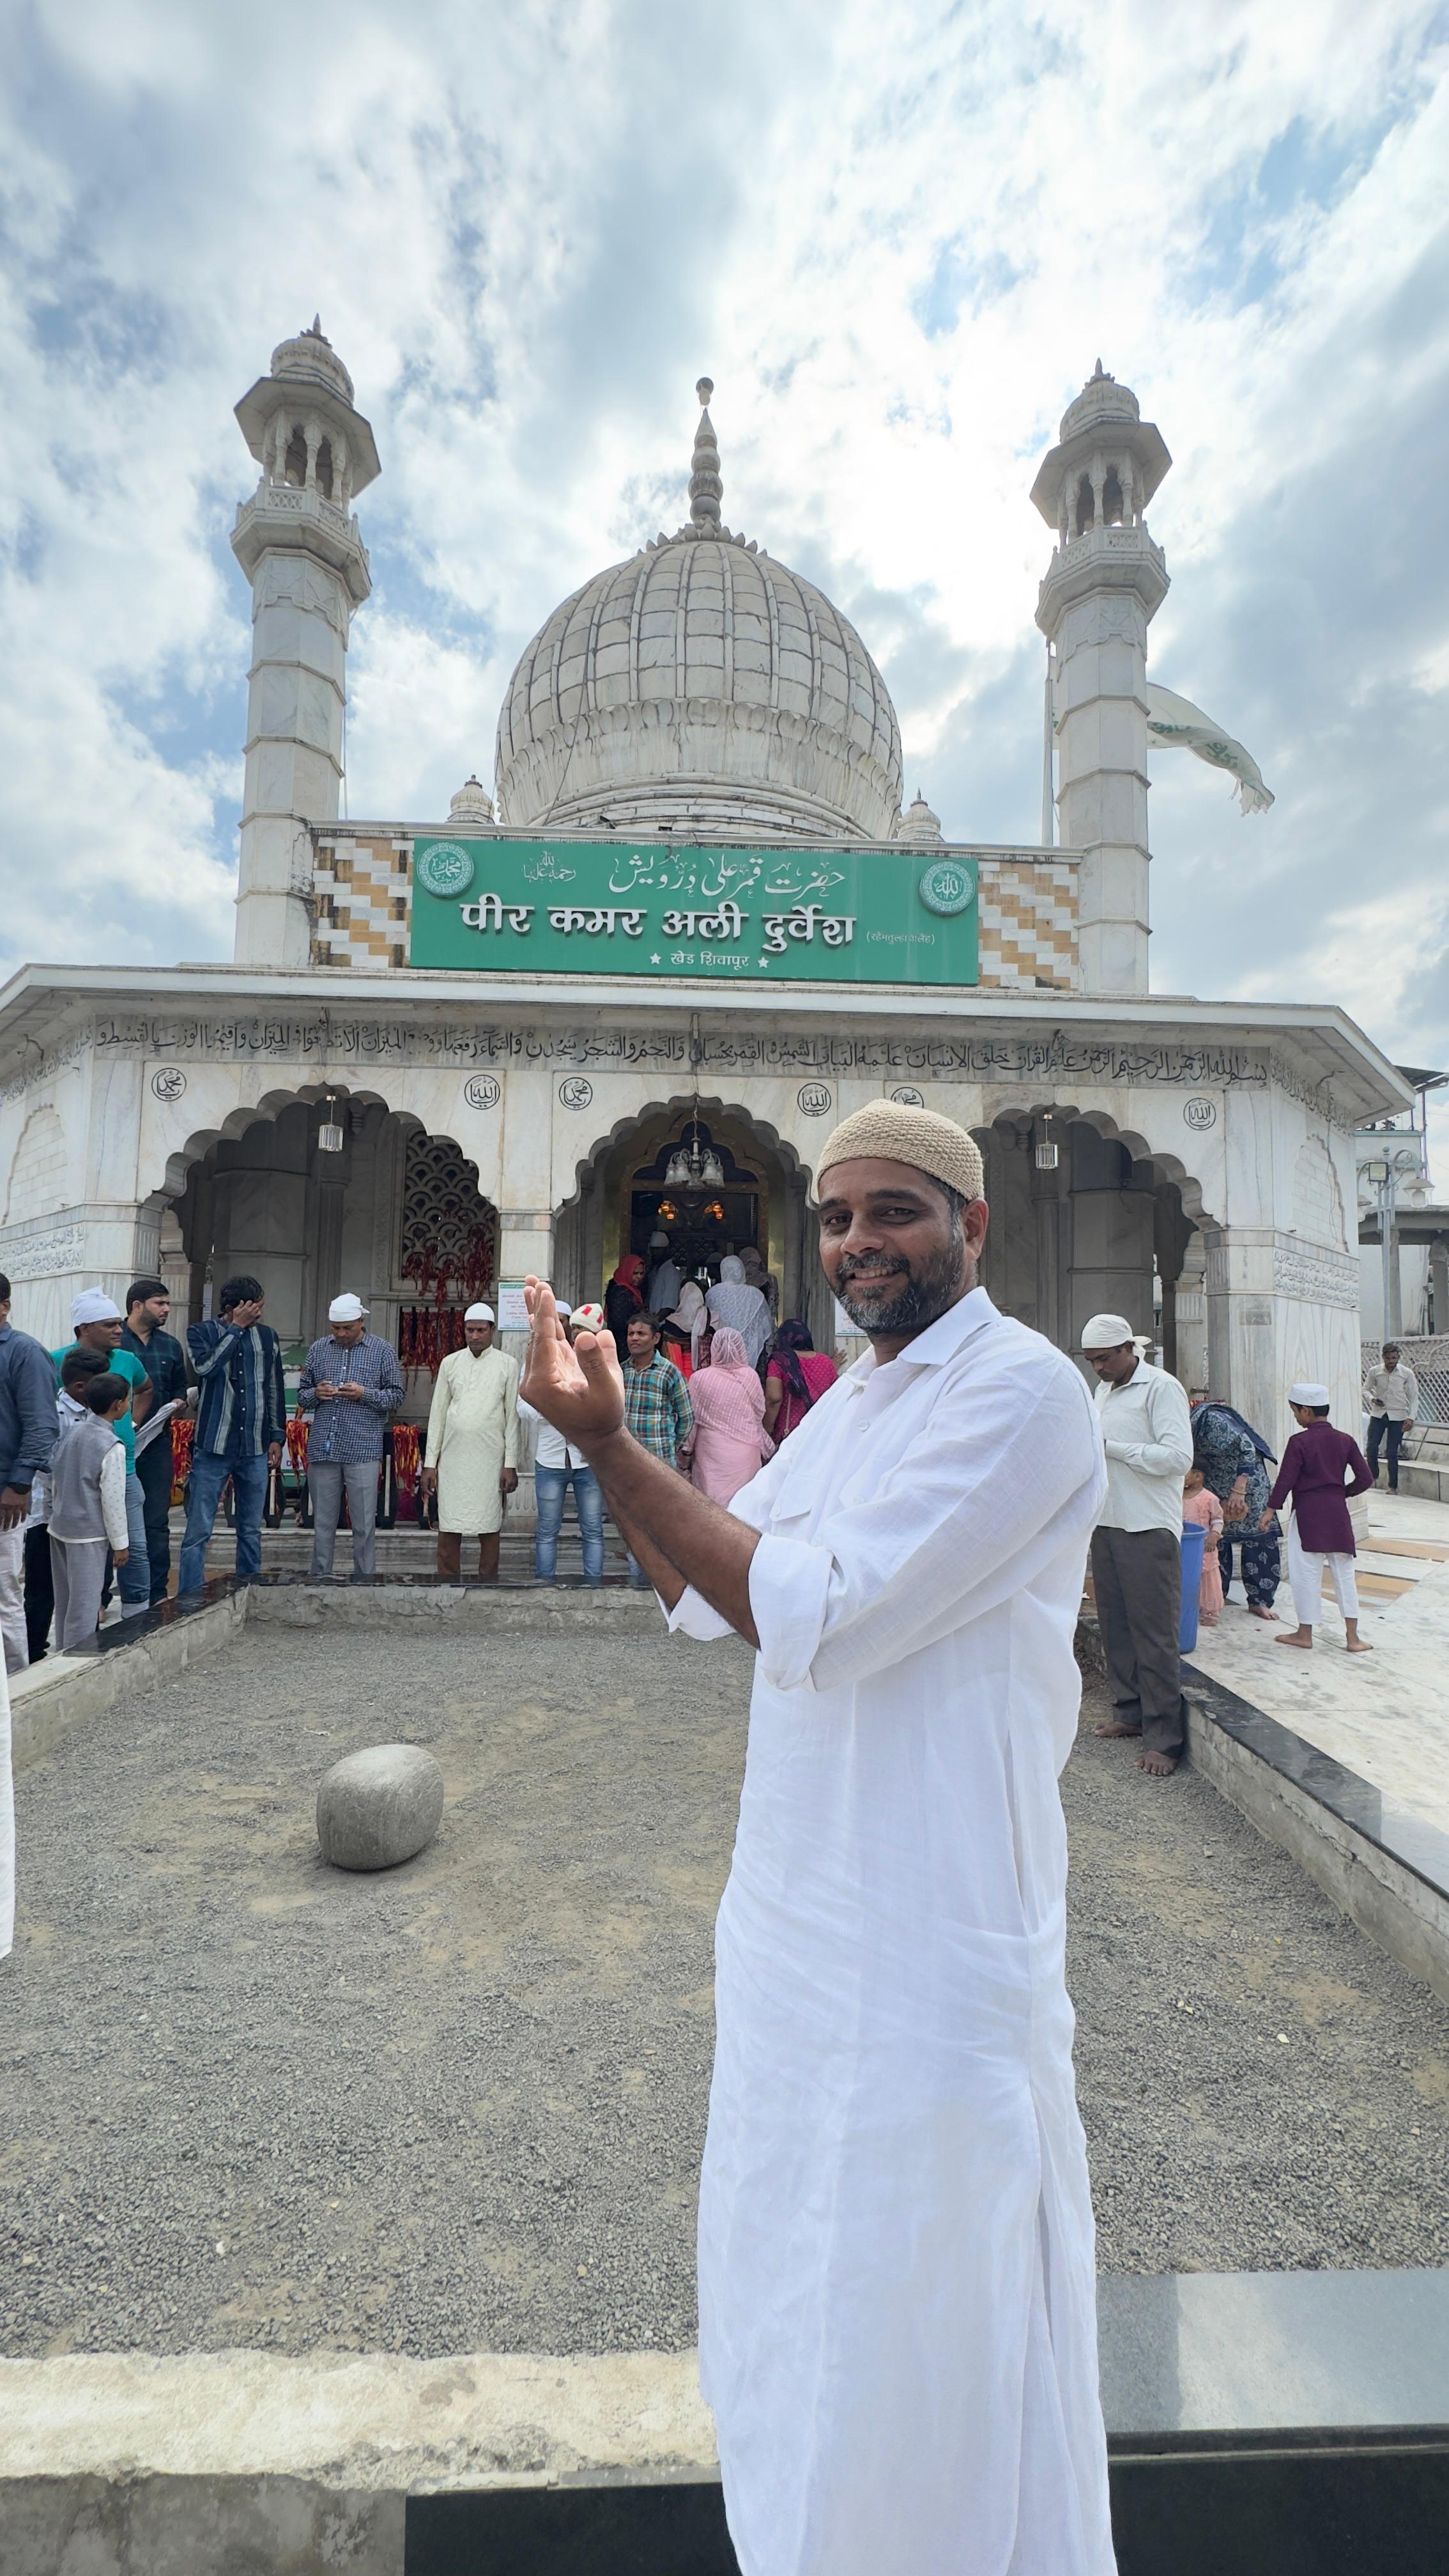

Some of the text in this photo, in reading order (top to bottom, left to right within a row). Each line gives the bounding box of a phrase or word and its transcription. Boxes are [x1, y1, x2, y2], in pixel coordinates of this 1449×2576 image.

[725, 855, 763, 900] قمر
[765, 865, 845, 901] حضرت
[459, 893, 857, 953] पीर कमर अली दुर्वेश
[670, 950, 750, 970] खेड शिवापूर
